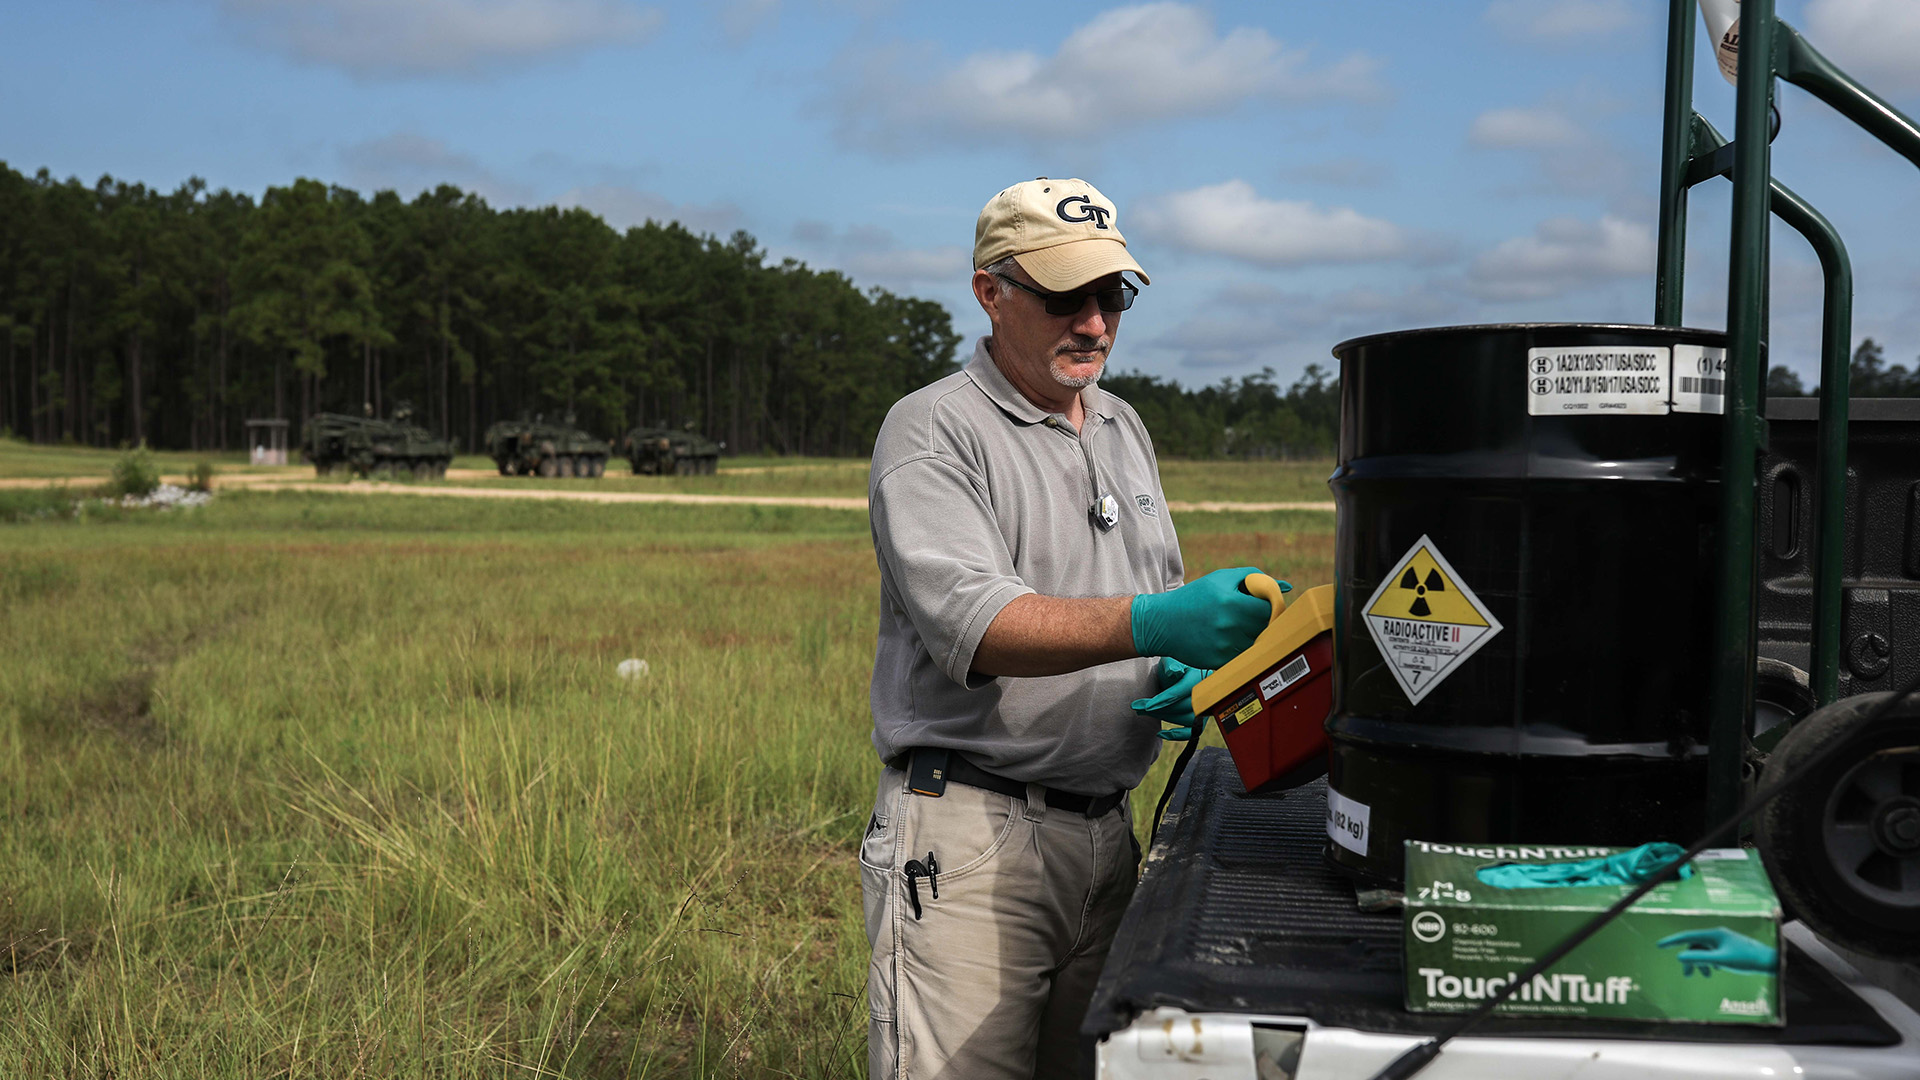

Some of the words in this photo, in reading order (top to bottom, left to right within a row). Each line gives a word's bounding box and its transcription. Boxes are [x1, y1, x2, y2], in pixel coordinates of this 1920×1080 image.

[1055, 194, 1110, 230] GT
[1697, 357, 1713, 374] (1)
[1383, 620, 1449, 642] RADIOACTIVE
[1412, 671, 1421, 684] 7
[1347, 816, 1364, 841] kg)
[1413, 840, 1610, 860] TouchNTuff
[1433, 880, 1454, 891] M
[1452, 923, 1498, 936] 92-600
